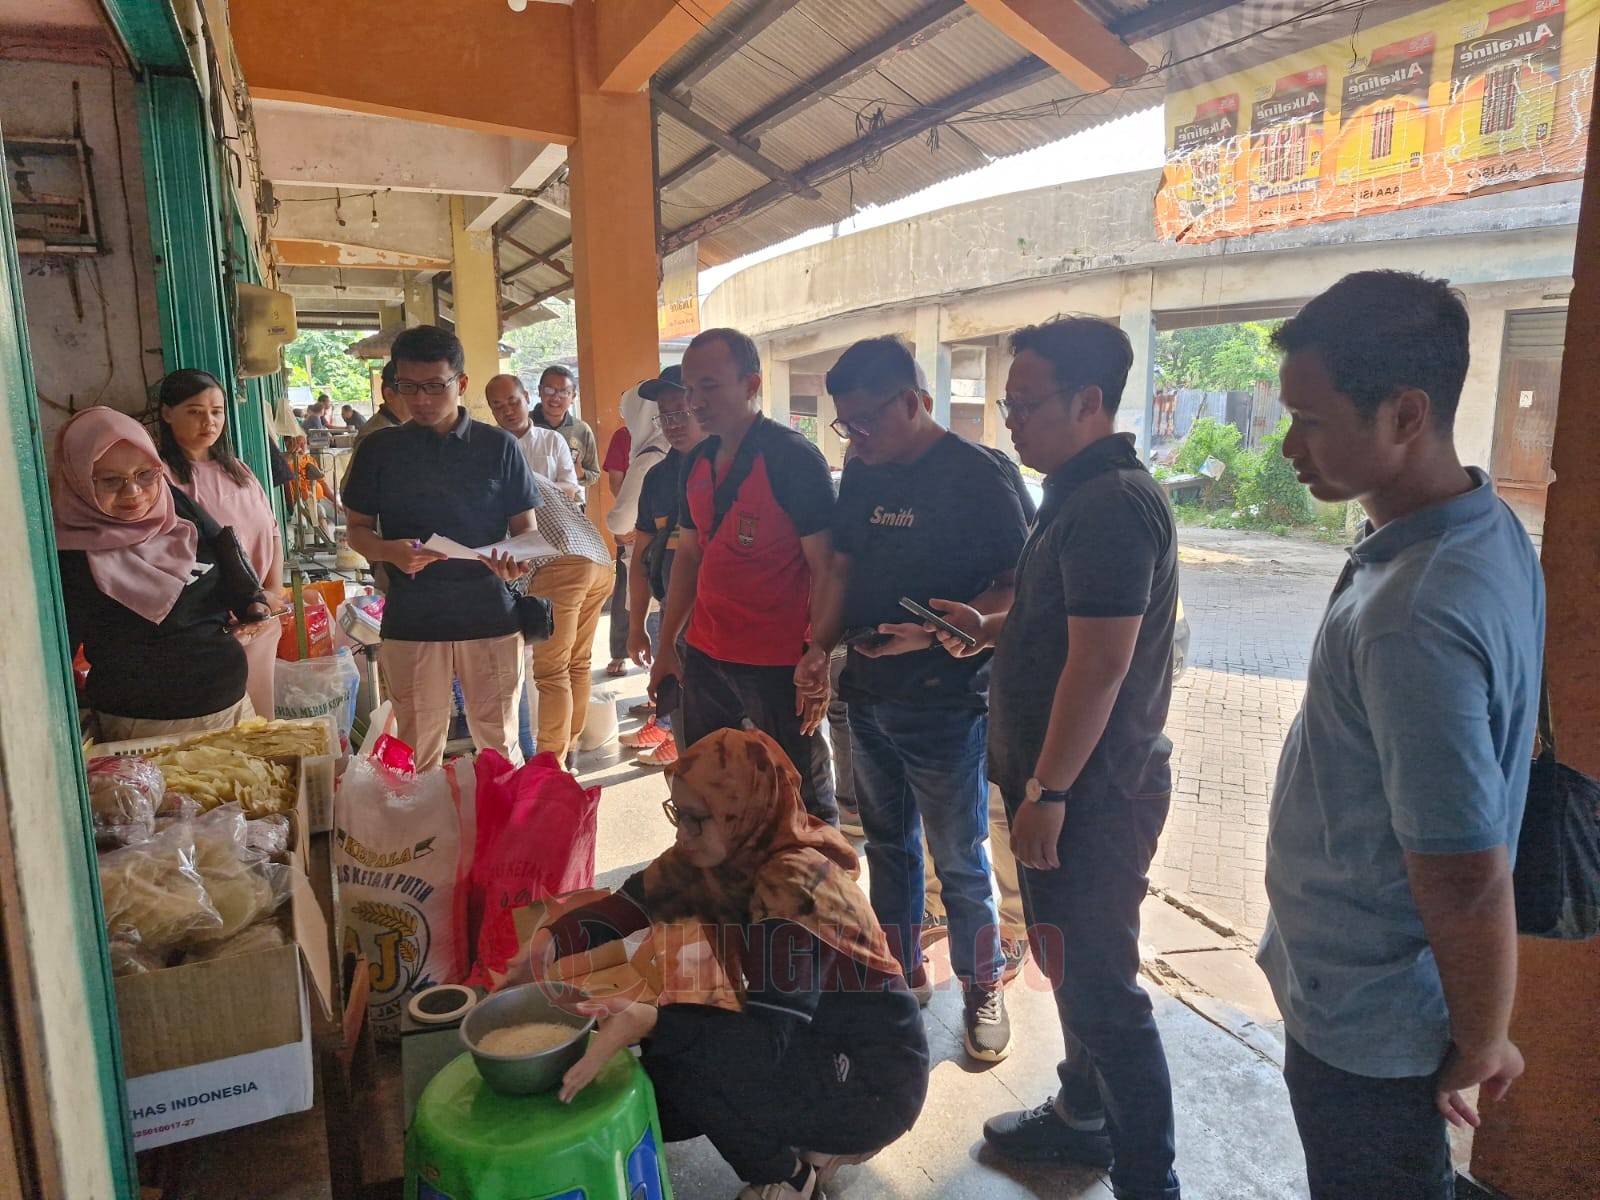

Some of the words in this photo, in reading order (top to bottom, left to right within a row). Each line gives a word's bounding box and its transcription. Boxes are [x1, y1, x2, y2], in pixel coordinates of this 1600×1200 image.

[870, 505, 914, 527] Smith
[344, 836, 411, 868] KEPALA
[352, 866, 394, 889] KETAN
[392, 873, 434, 903] PUTIH
[130, 1103, 167, 1120] HAS
[171, 1081, 258, 1110] INDONESIA
